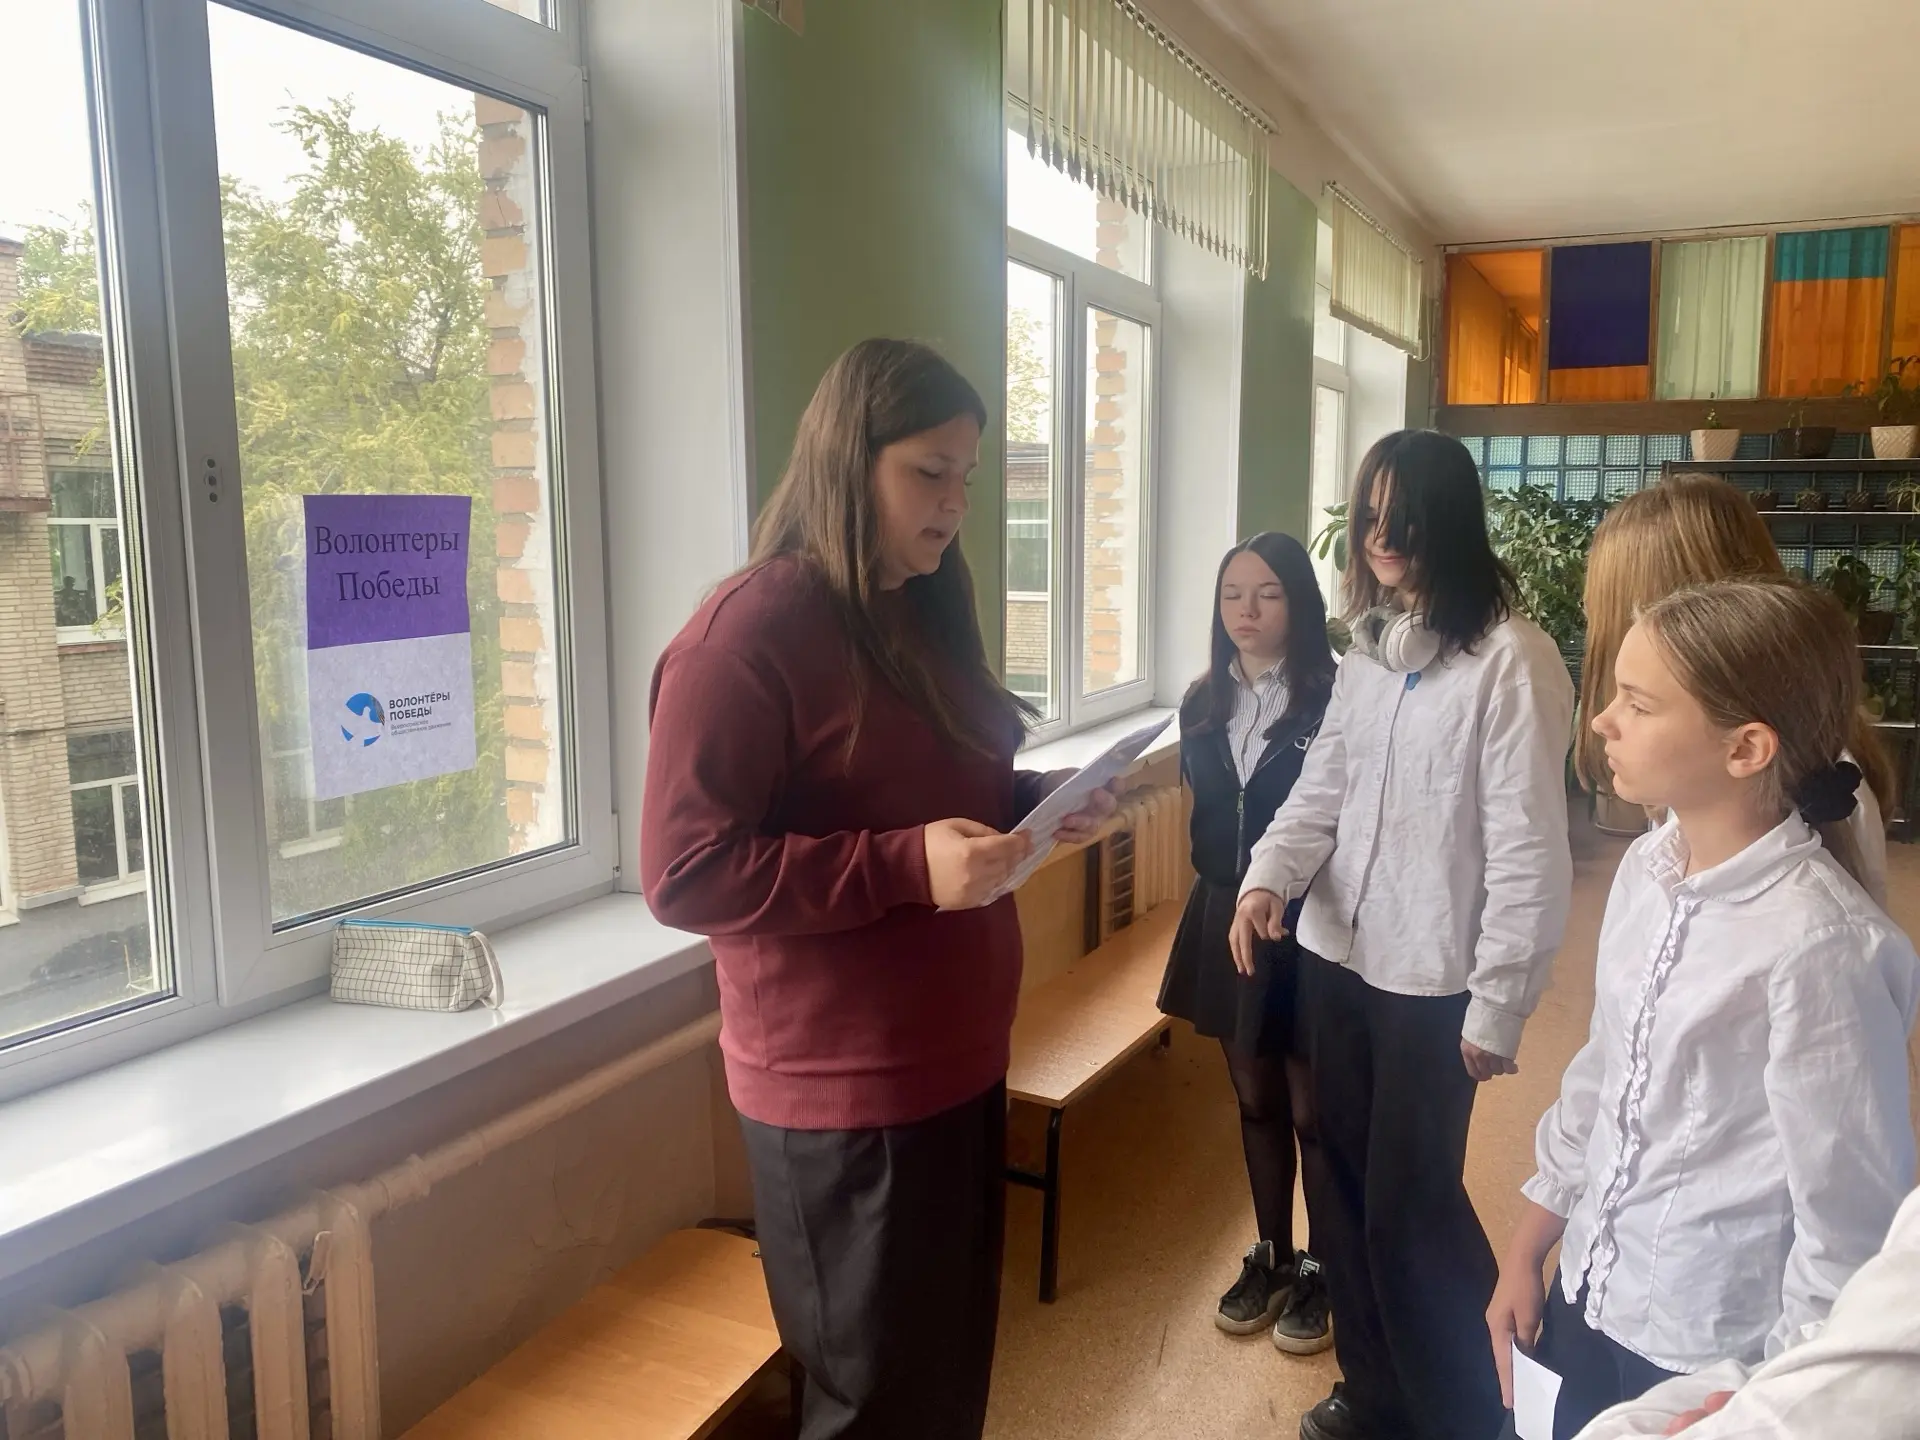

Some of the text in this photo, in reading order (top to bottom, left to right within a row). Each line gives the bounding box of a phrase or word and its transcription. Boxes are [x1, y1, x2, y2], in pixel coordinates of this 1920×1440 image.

[314, 526, 460, 559] Волонтеры
[336, 570, 441, 601] Победы
[389, 691, 450, 709] ВОЛОНТЁРЫ
[389, 706, 432, 721] ПОБЕДЫ
